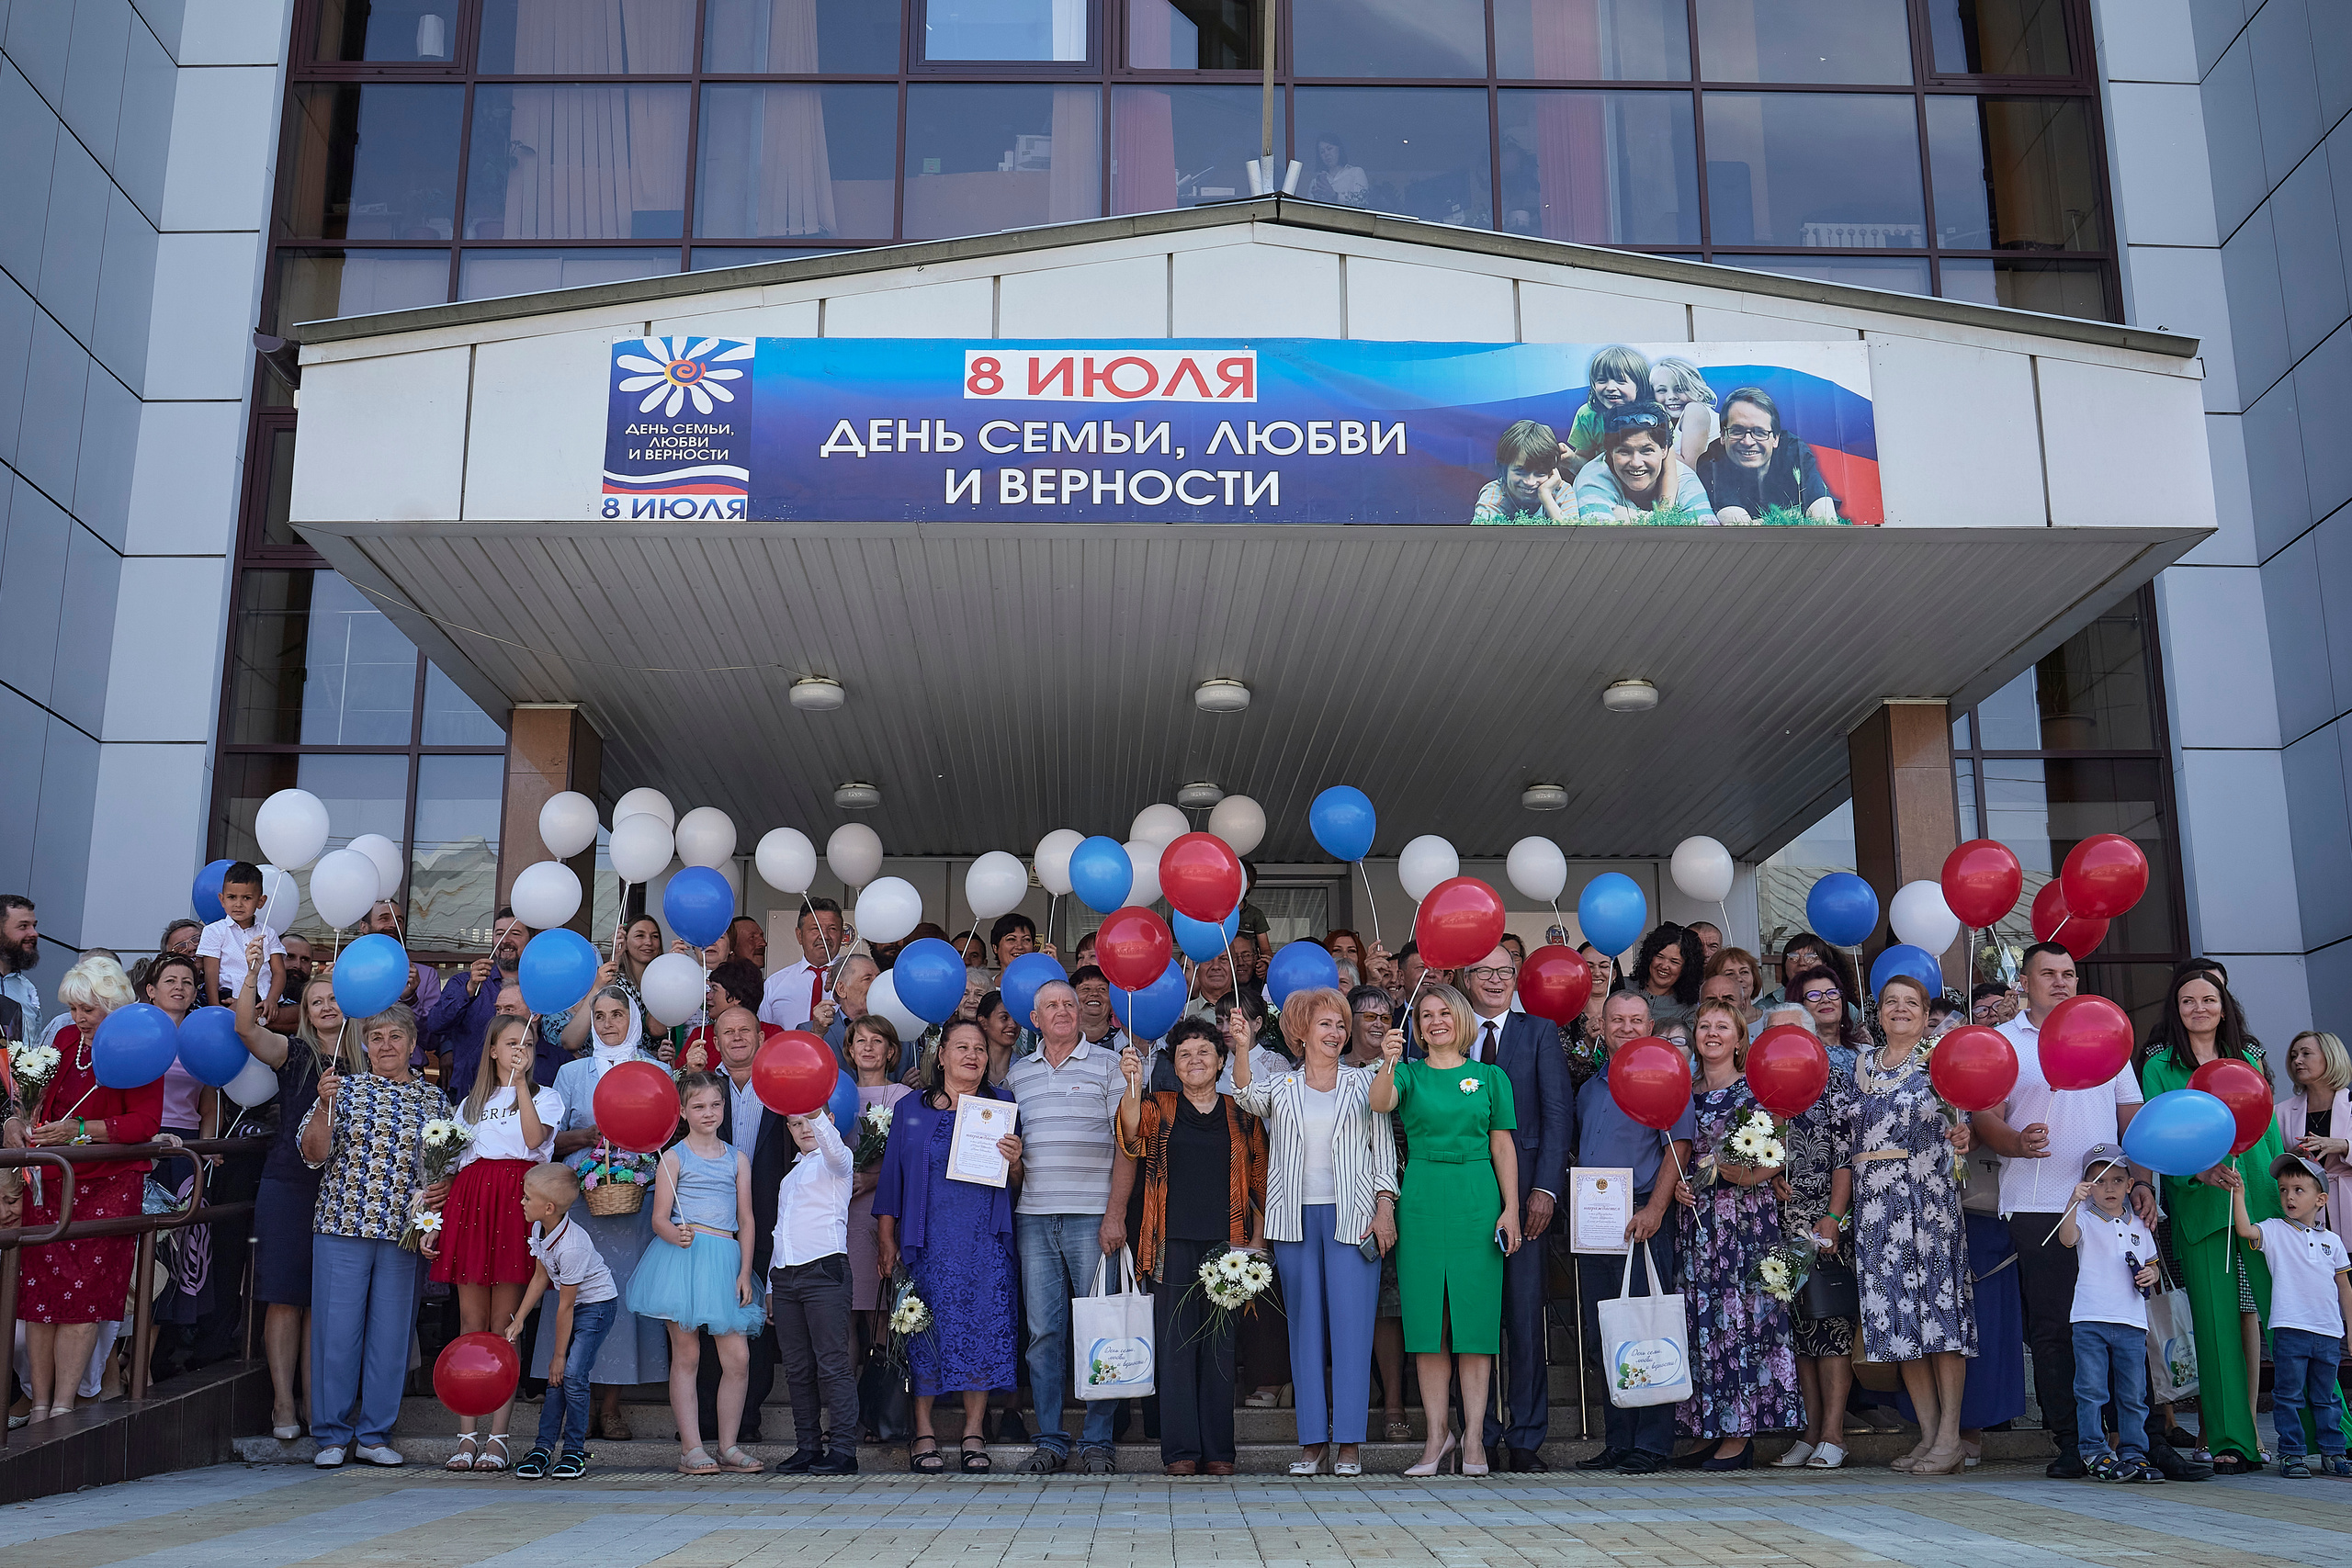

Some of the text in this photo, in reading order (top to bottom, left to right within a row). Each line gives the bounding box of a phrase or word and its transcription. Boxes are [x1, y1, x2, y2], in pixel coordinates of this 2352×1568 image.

[966, 355, 1254, 399] 8 ИЮЛЯ
[625, 423, 735, 436] ДЕНЬ СЕМЬИ,
[820, 418, 1407, 460] ДЕНЬ СЕМЬИ, ЛЮБВИ
[649, 436, 709, 448] ЛЮБВИ
[628, 448, 729, 461] И ВЕРНОСТИ
[944, 467, 1280, 507] И ВЕРНОСТИ
[601, 497, 746, 520] 8 ИЮЛЯ
